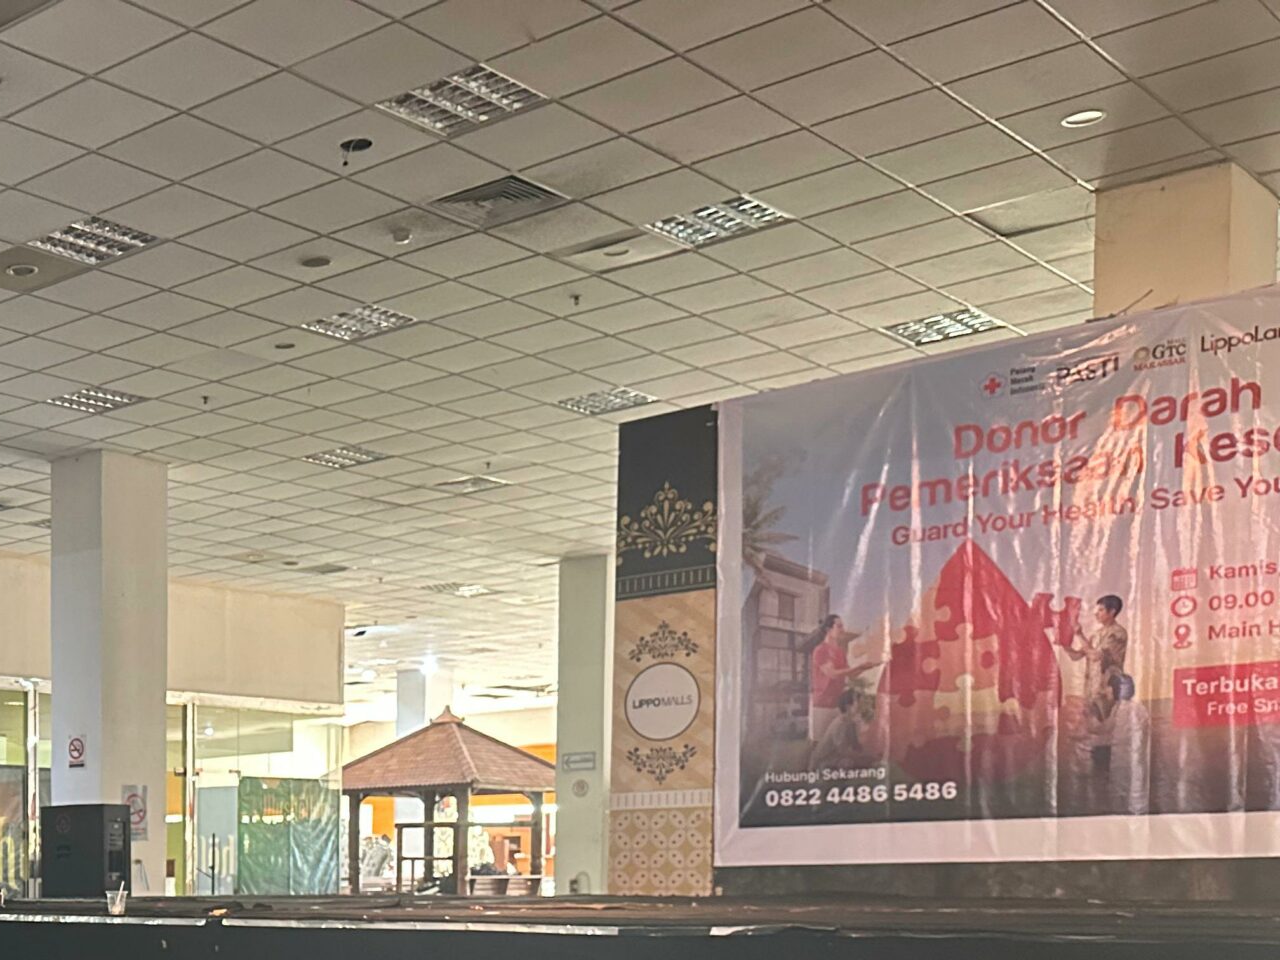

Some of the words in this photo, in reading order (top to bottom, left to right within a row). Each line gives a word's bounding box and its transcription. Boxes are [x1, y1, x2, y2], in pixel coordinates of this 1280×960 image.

[1151, 341, 1188, 361] GTC
[953, 410, 1088, 460] Donor
[1113, 376, 1262, 431] Darah
[860, 445, 1145, 517] Pemeriksaan
[891, 515, 970, 547] Guard
[976, 511, 1034, 536] Your
[1149, 482, 1226, 511] Save
[1208, 589, 1275, 612] 09.00
[1207, 619, 1261, 642] Main
[1182, 672, 1279, 697] Terbuka
[1206, 700, 1249, 717] Free
[764, 770, 820, 785] Hubungi
[821, 766, 887, 781] Sekarang
[764, 788, 822, 808] 0822
[825, 784, 889, 805] 4486
[893, 780, 958, 802] 5486
